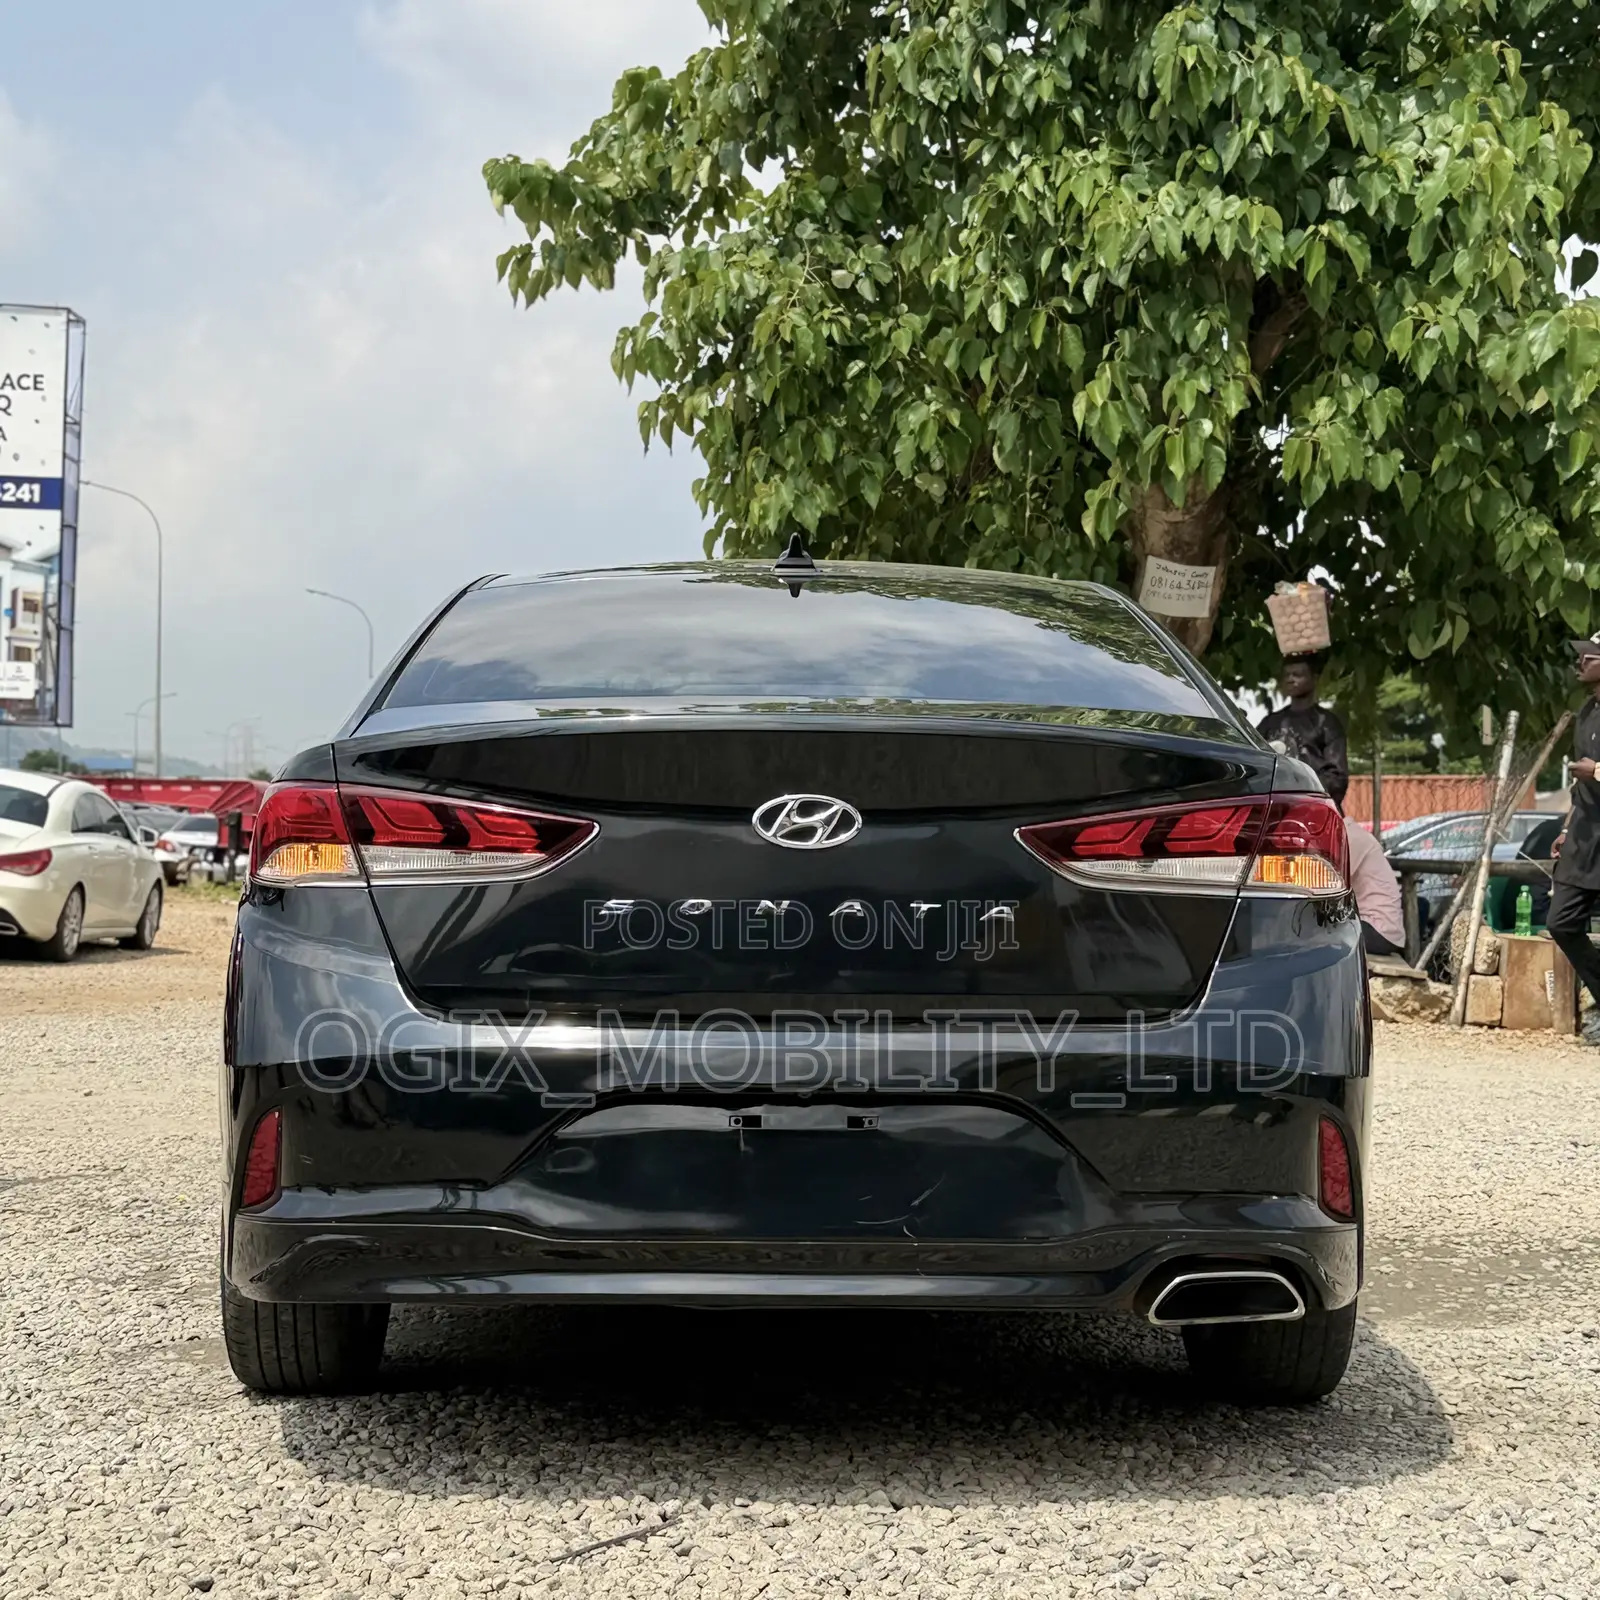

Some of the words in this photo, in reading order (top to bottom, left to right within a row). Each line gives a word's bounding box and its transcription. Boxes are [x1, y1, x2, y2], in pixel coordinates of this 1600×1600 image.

[0, 373, 44, 391] ACE
[0, 482, 41, 503] 241
[599, 899, 1015, 922] SONATA
